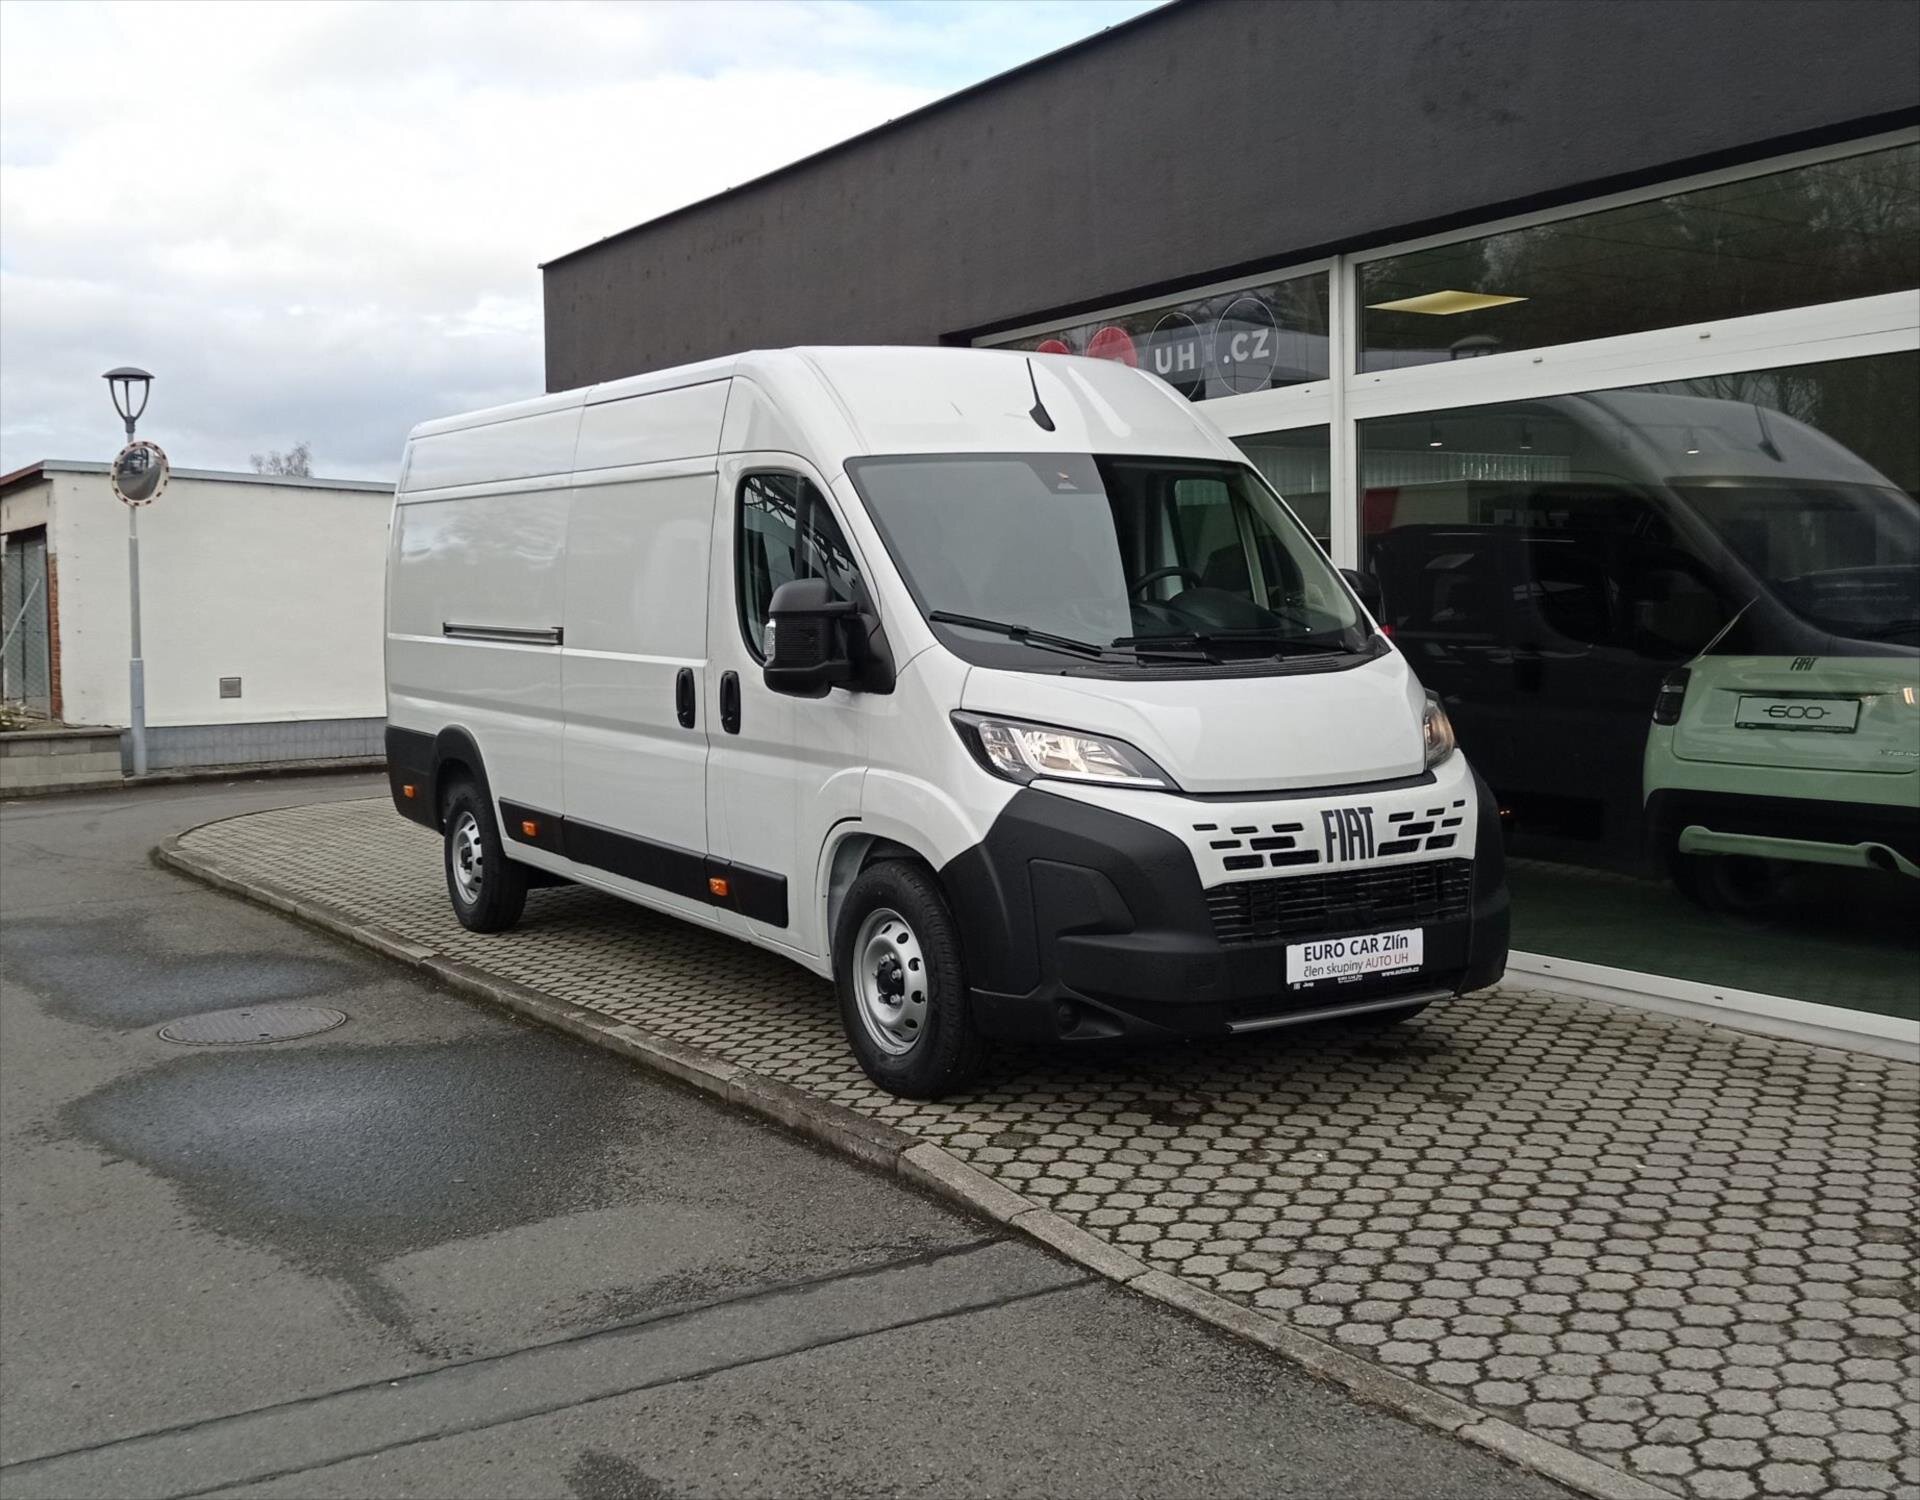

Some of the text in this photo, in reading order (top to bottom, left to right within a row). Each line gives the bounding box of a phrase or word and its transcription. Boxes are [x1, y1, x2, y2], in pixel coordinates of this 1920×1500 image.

[1155, 328, 1270, 374] UH .CZ
[1790, 656, 1818, 671] FIAT
[1320, 806, 1374, 863] FIAT
[1304, 934, 1408, 961] EURO CAR Zlín
[1303, 953, 1408, 978] člen skupiny AUTO UH
